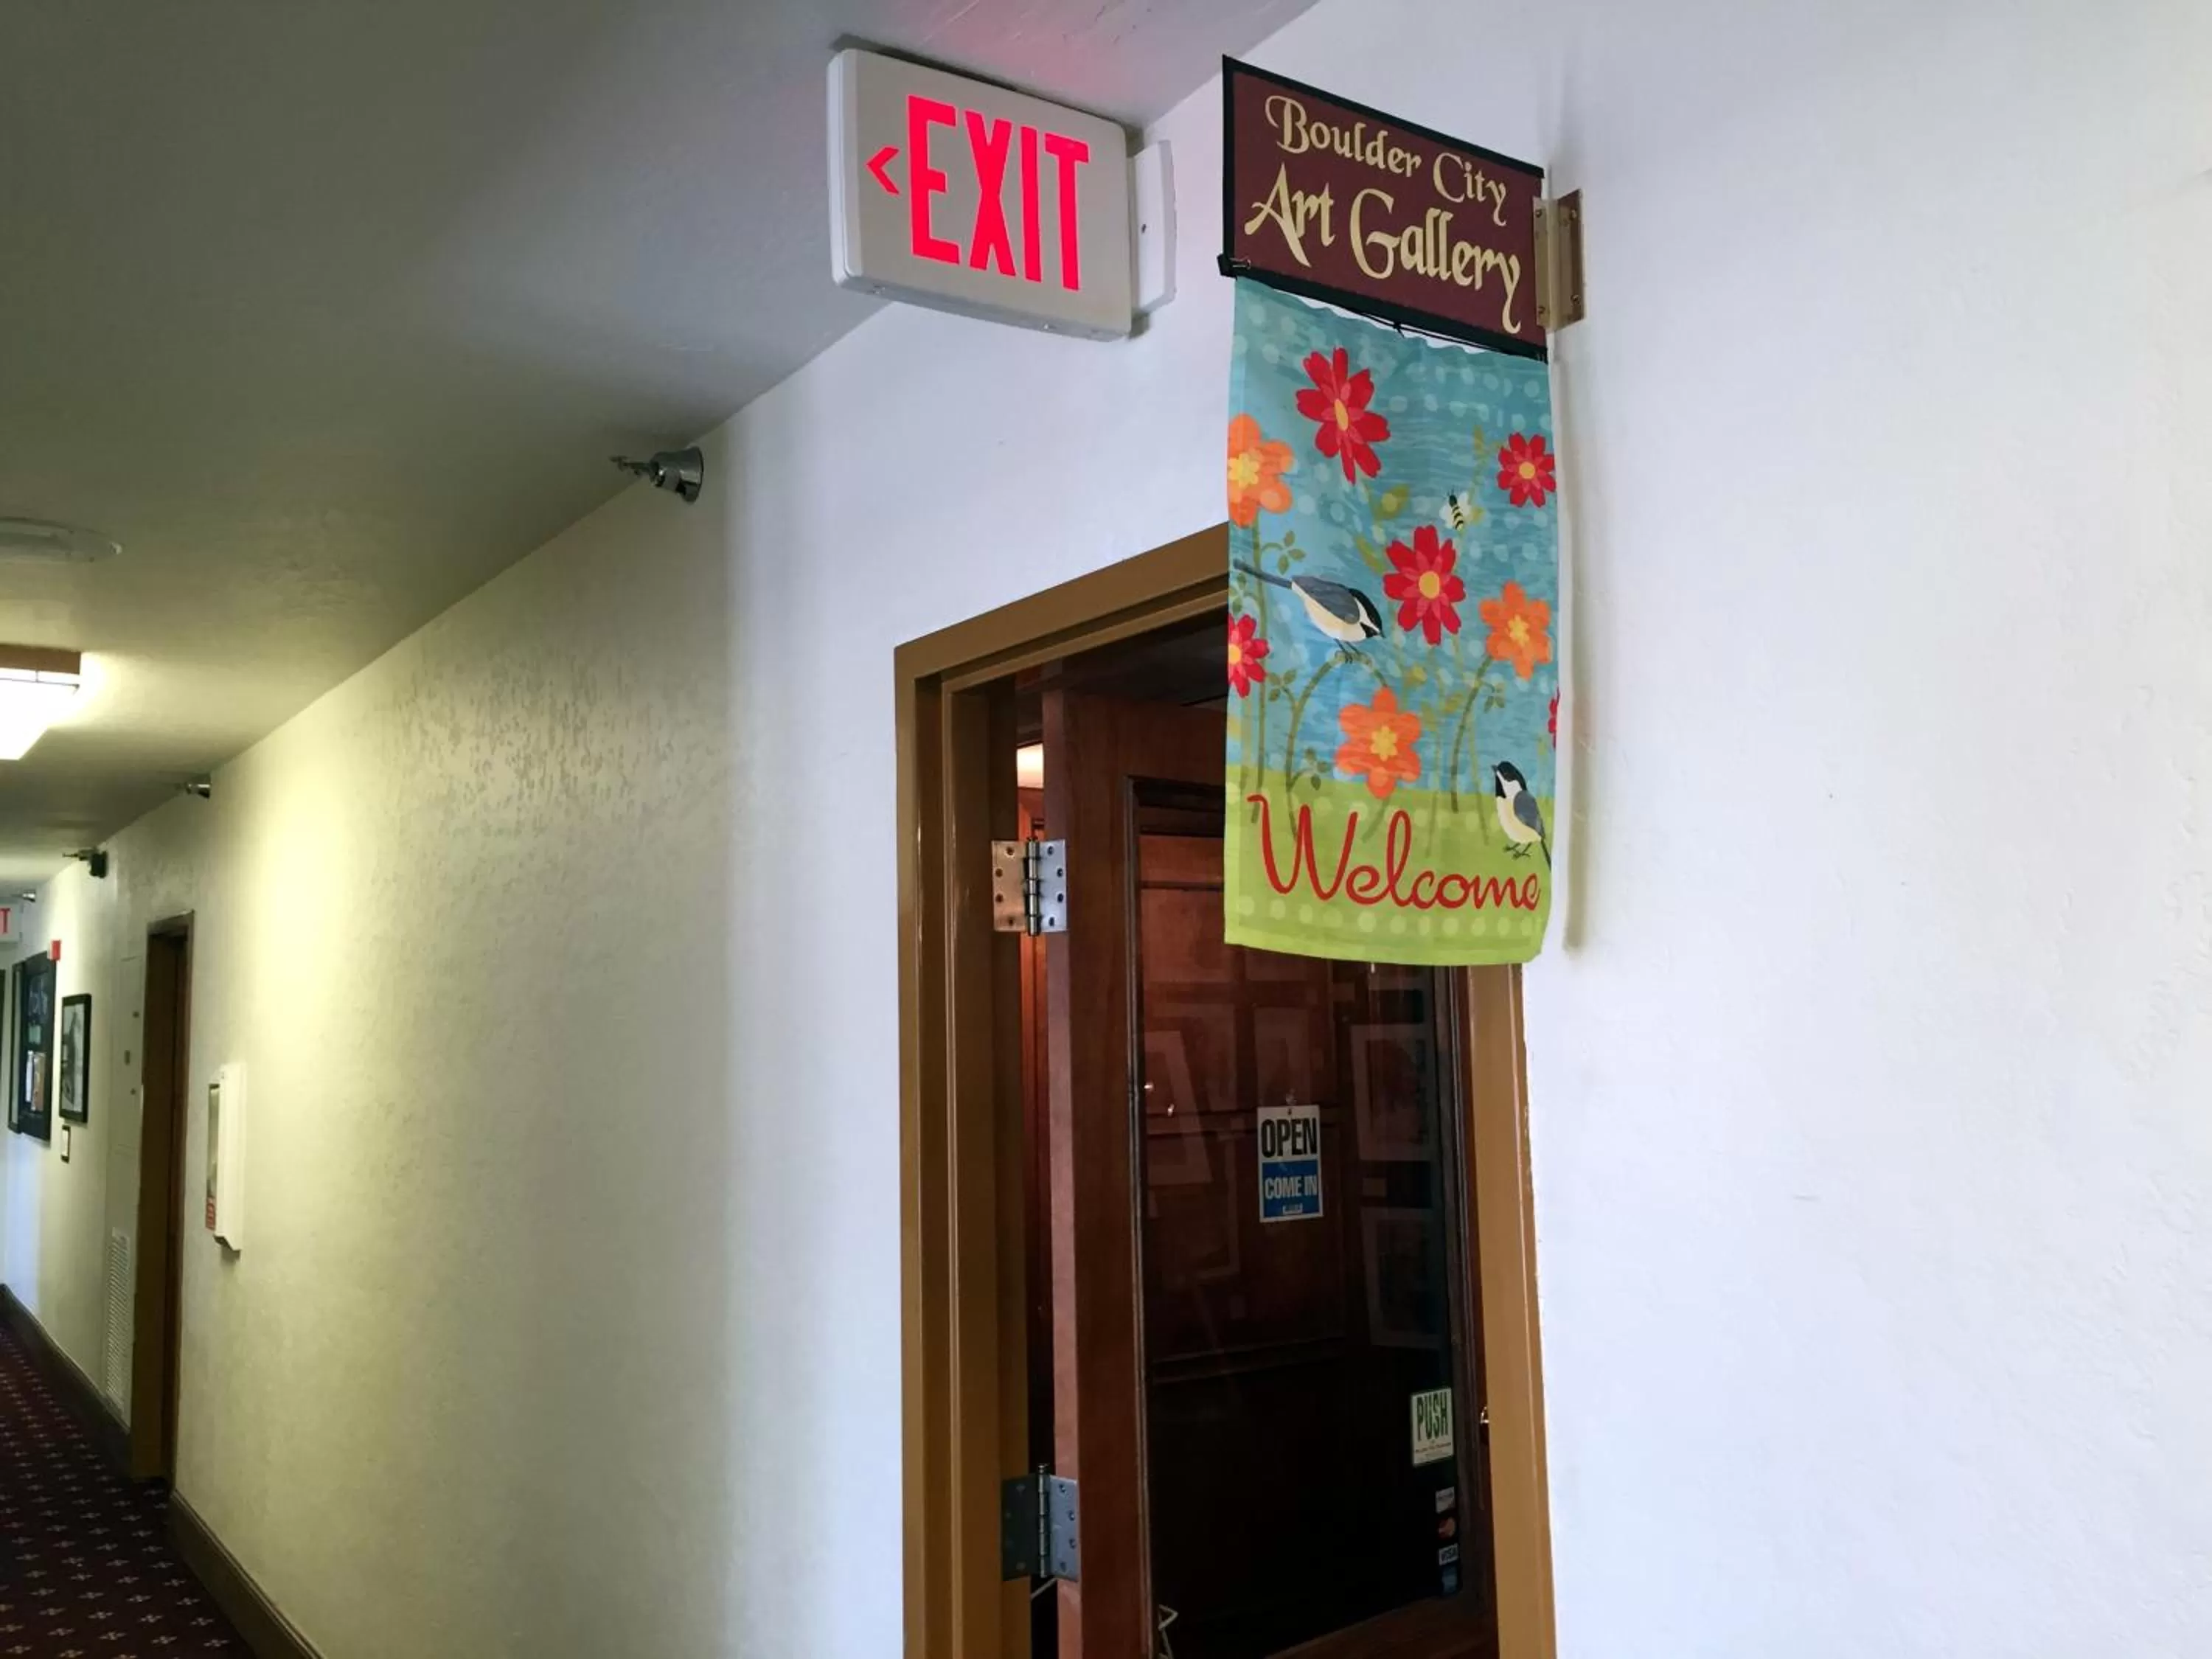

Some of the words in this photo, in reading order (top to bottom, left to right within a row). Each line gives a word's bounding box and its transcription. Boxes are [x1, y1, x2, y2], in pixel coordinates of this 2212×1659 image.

[908, 94, 1090, 291] EXIT
[1265, 95, 1422, 178] Boulder
[1433, 153, 1507, 226] City
[1244, 162, 1336, 268] Art
[1349, 188, 1522, 334] Gallery
[1247, 794, 1540, 911] Welcome
[1261, 1118, 1317, 1158] OPEN
[1265, 1178, 1302, 1199] COME
[1304, 1175, 1317, 1196] IN
[1416, 1391, 1449, 1441] PUSH
